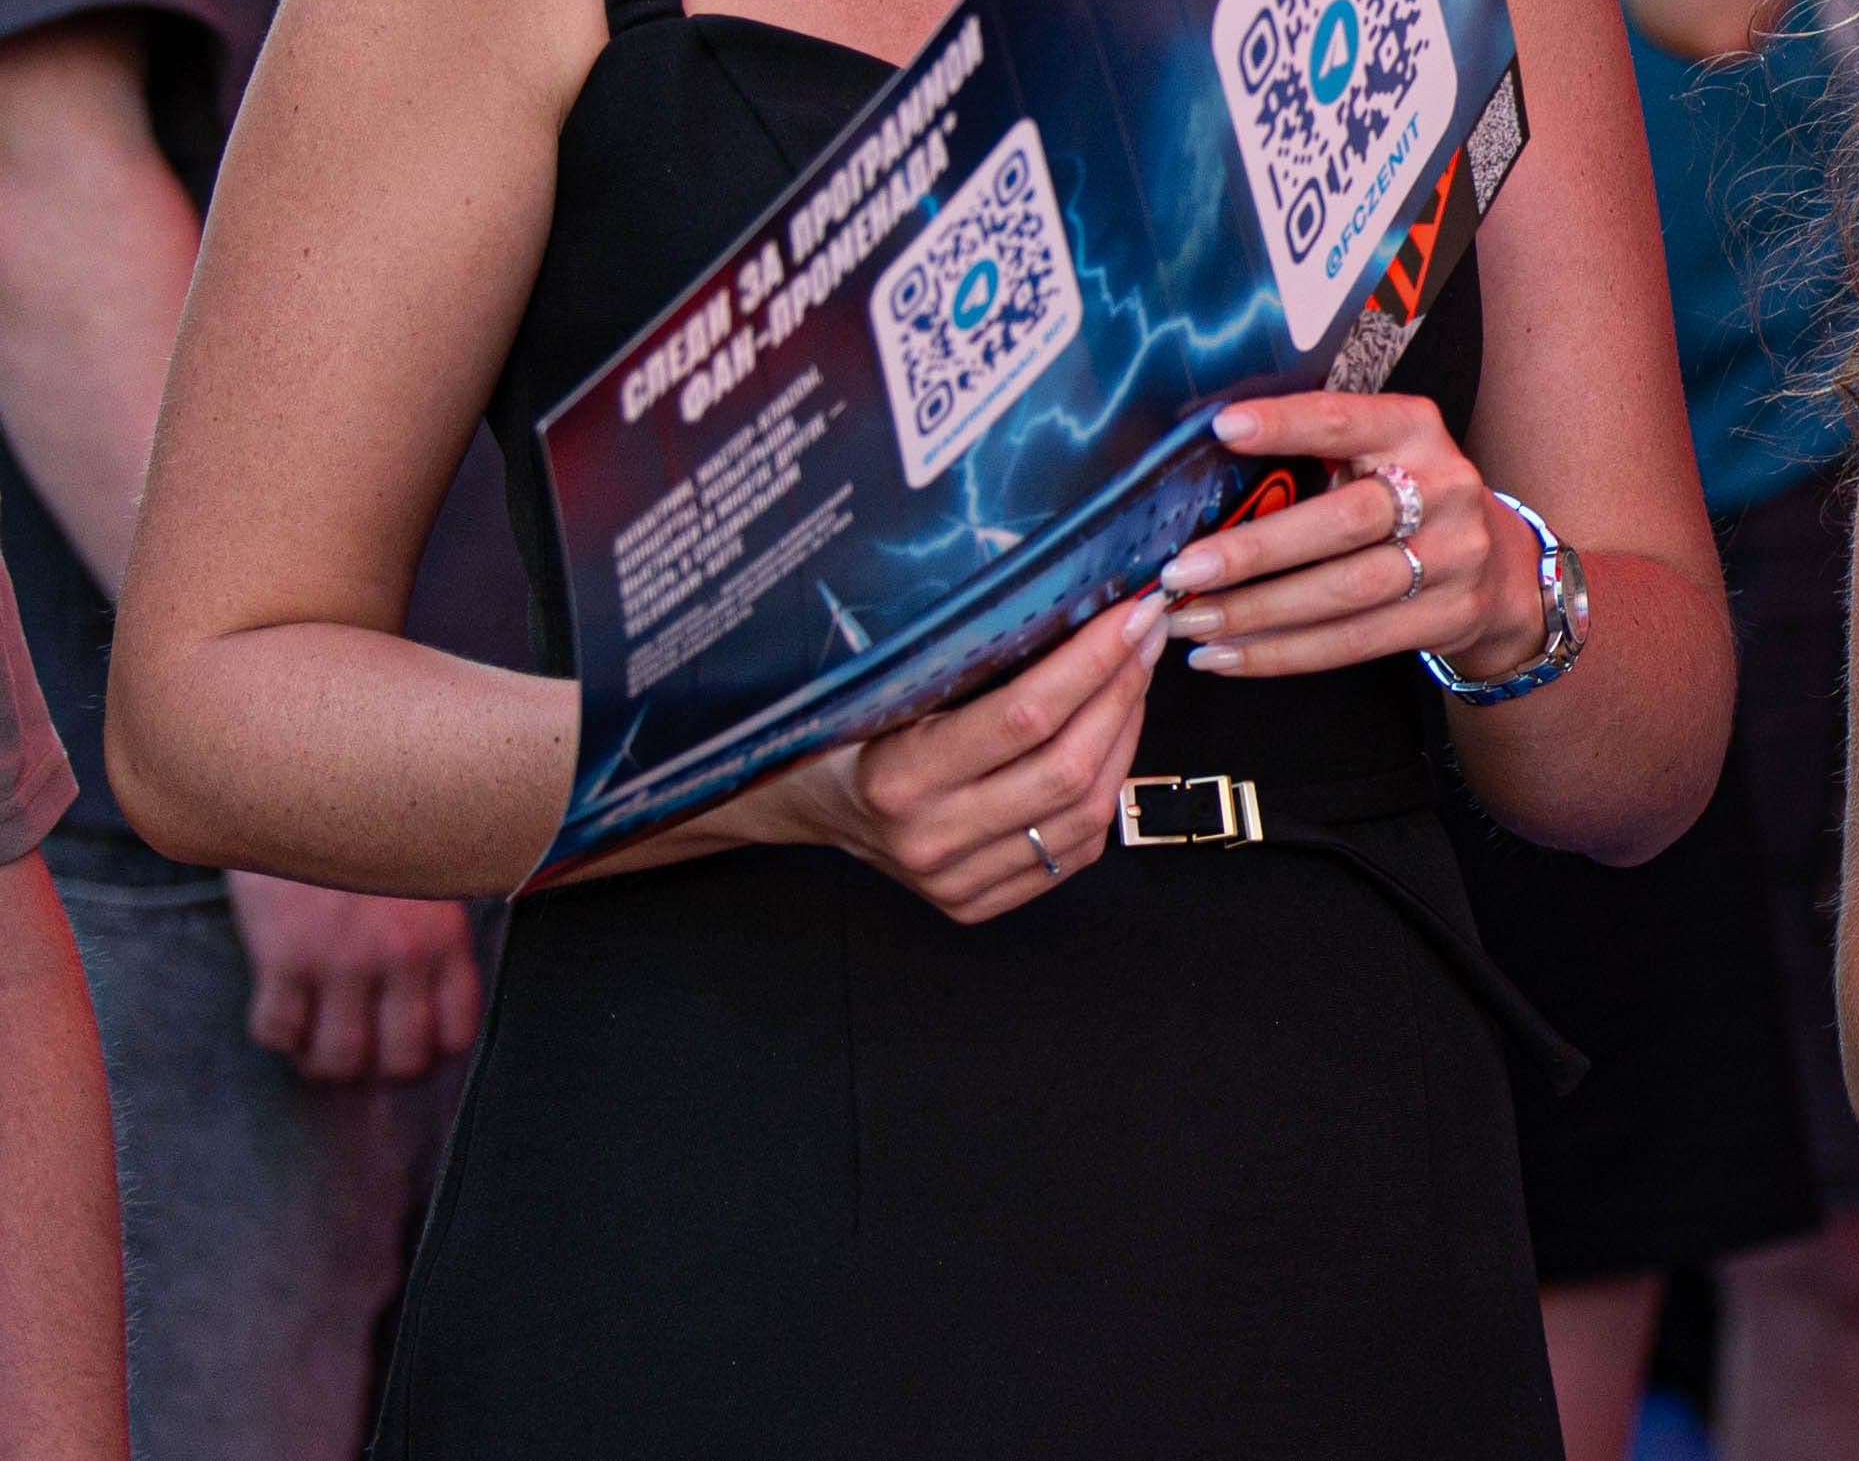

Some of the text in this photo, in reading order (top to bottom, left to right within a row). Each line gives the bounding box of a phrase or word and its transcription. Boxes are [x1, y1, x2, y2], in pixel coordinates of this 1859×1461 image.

[1326, 110, 1420, 279] @FCZENIT
[620, 288, 732, 423] СЛЕДИ
[737, 239, 785, 315] ЗА
